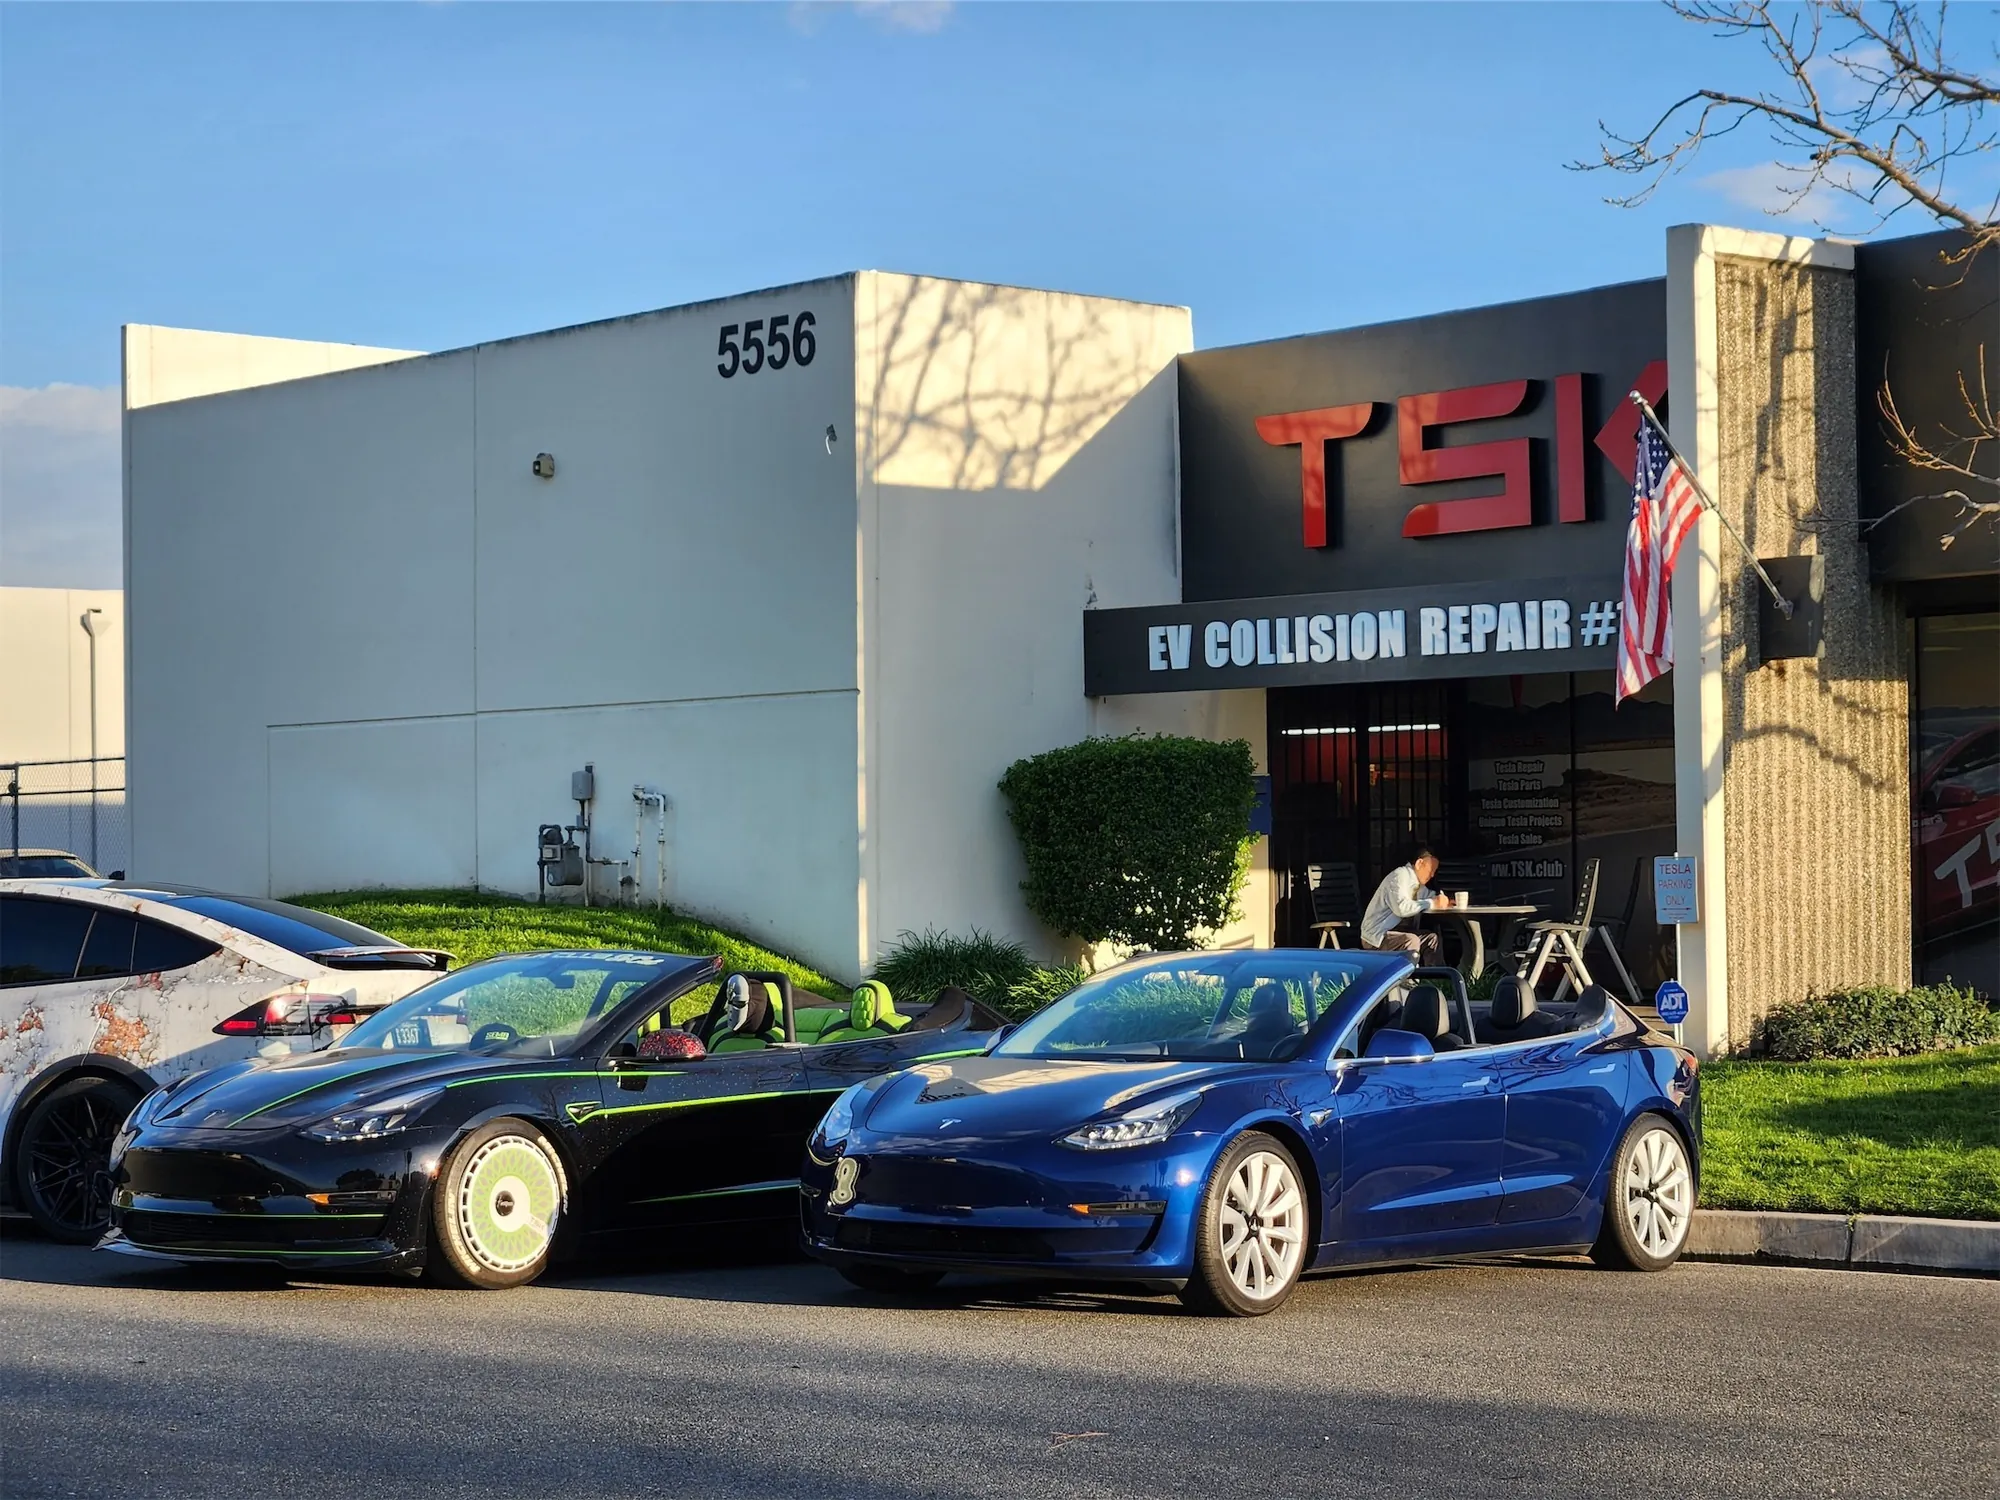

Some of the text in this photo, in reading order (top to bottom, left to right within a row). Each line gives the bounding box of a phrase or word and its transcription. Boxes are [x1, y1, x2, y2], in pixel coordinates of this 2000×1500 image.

[717, 310, 816, 379] 5556
[1254, 359, 1669, 549] TSK
[1148, 623, 1192, 671] EV
[1204, 609, 1406, 669] COLLISION
[1420, 599, 1571, 656] REPAIR
[1495, 760, 1544, 774] Tesla Repair
[1498, 779, 1541, 791] Tesla Parts
[1481, 797, 1559, 809] Tesla Customization
[1507, 815, 1528, 827] Tesla
[1528, 814, 1563, 827] Projects
[1498, 833, 1543, 845] Tesla Sales
[1480, 860, 1564, 878] ww.TSK.club
[1659, 863, 1691, 875] TESLA
[1658, 879, 1692, 890] PARKING
[1665, 895, 1686, 906] ONLY
[1660, 992, 1686, 1011] ADT
